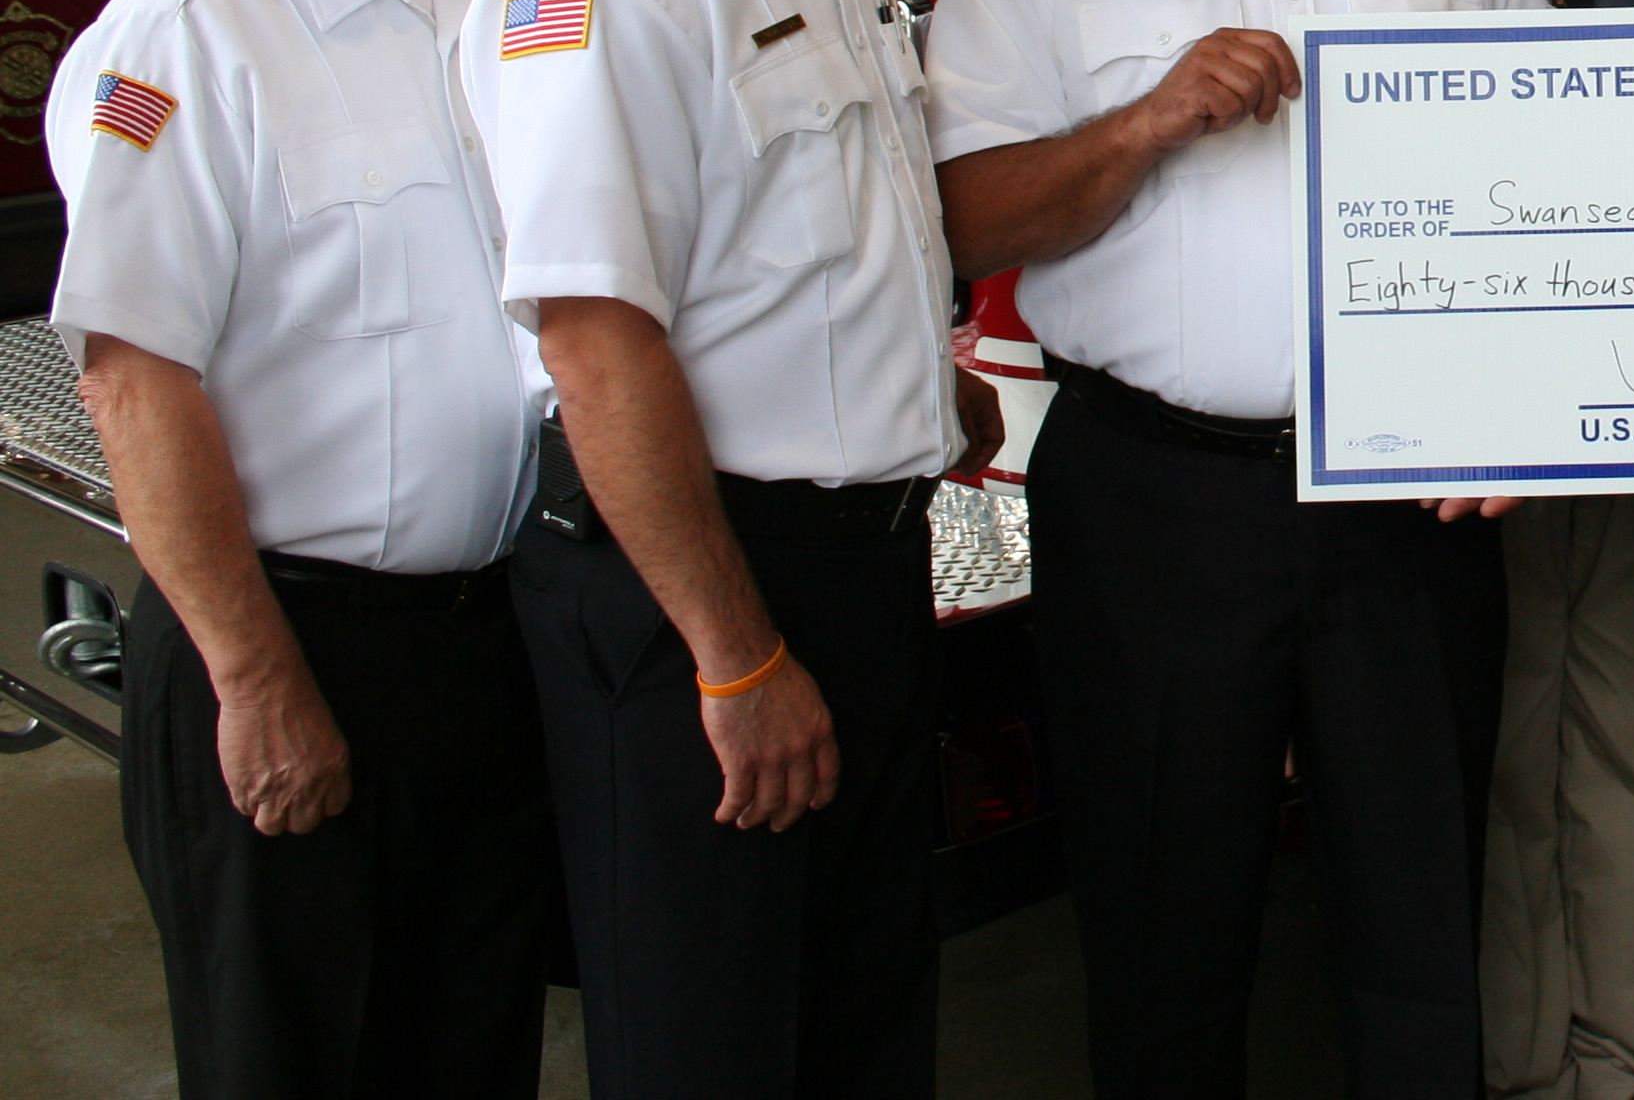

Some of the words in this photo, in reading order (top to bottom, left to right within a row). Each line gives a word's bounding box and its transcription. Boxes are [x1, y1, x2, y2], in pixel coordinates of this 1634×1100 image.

[1344, 69, 1497, 104] UNITED
[1338, 201, 1376, 218] PAY
[1380, 200, 1409, 217] TO
[1414, 199, 1455, 216] THE
[1343, 221, 1416, 239] ORDER
[1422, 220, 1450, 237] OF
[1345, 258, 1528, 310] Eighty-six
